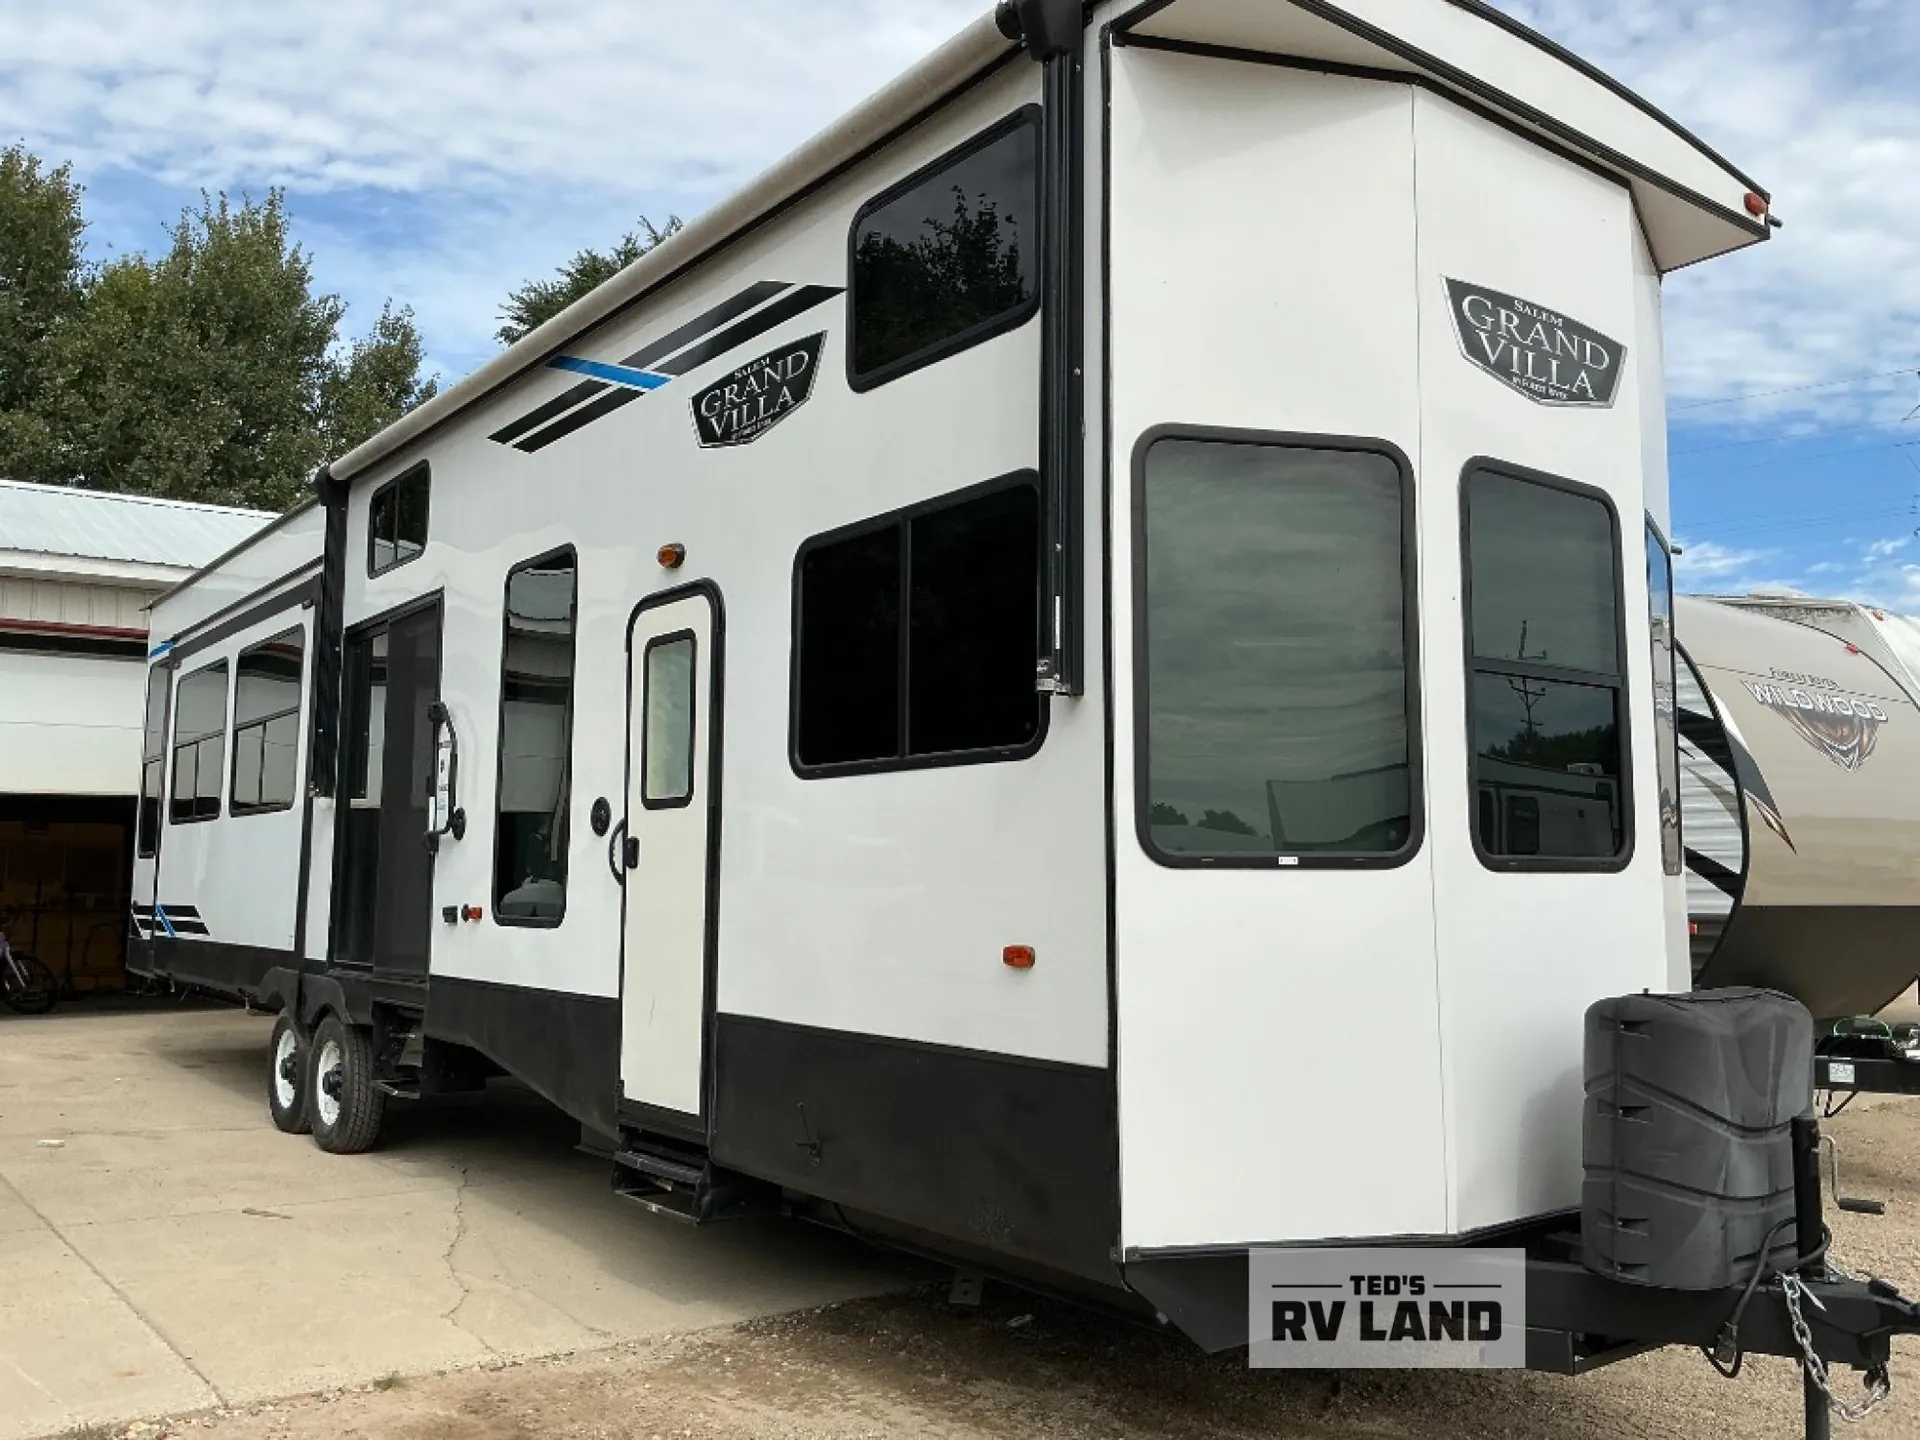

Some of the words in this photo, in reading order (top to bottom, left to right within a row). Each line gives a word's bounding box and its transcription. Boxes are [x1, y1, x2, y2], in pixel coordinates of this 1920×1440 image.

[1462, 295, 1609, 370] GRAND
[1514, 299, 1563, 327] SALEM
[700, 350, 809, 418] GRAND
[1475, 329, 1597, 400] VILLA
[709, 385, 796, 438] VILLA
[1741, 680, 1889, 723] WILDWOOD
